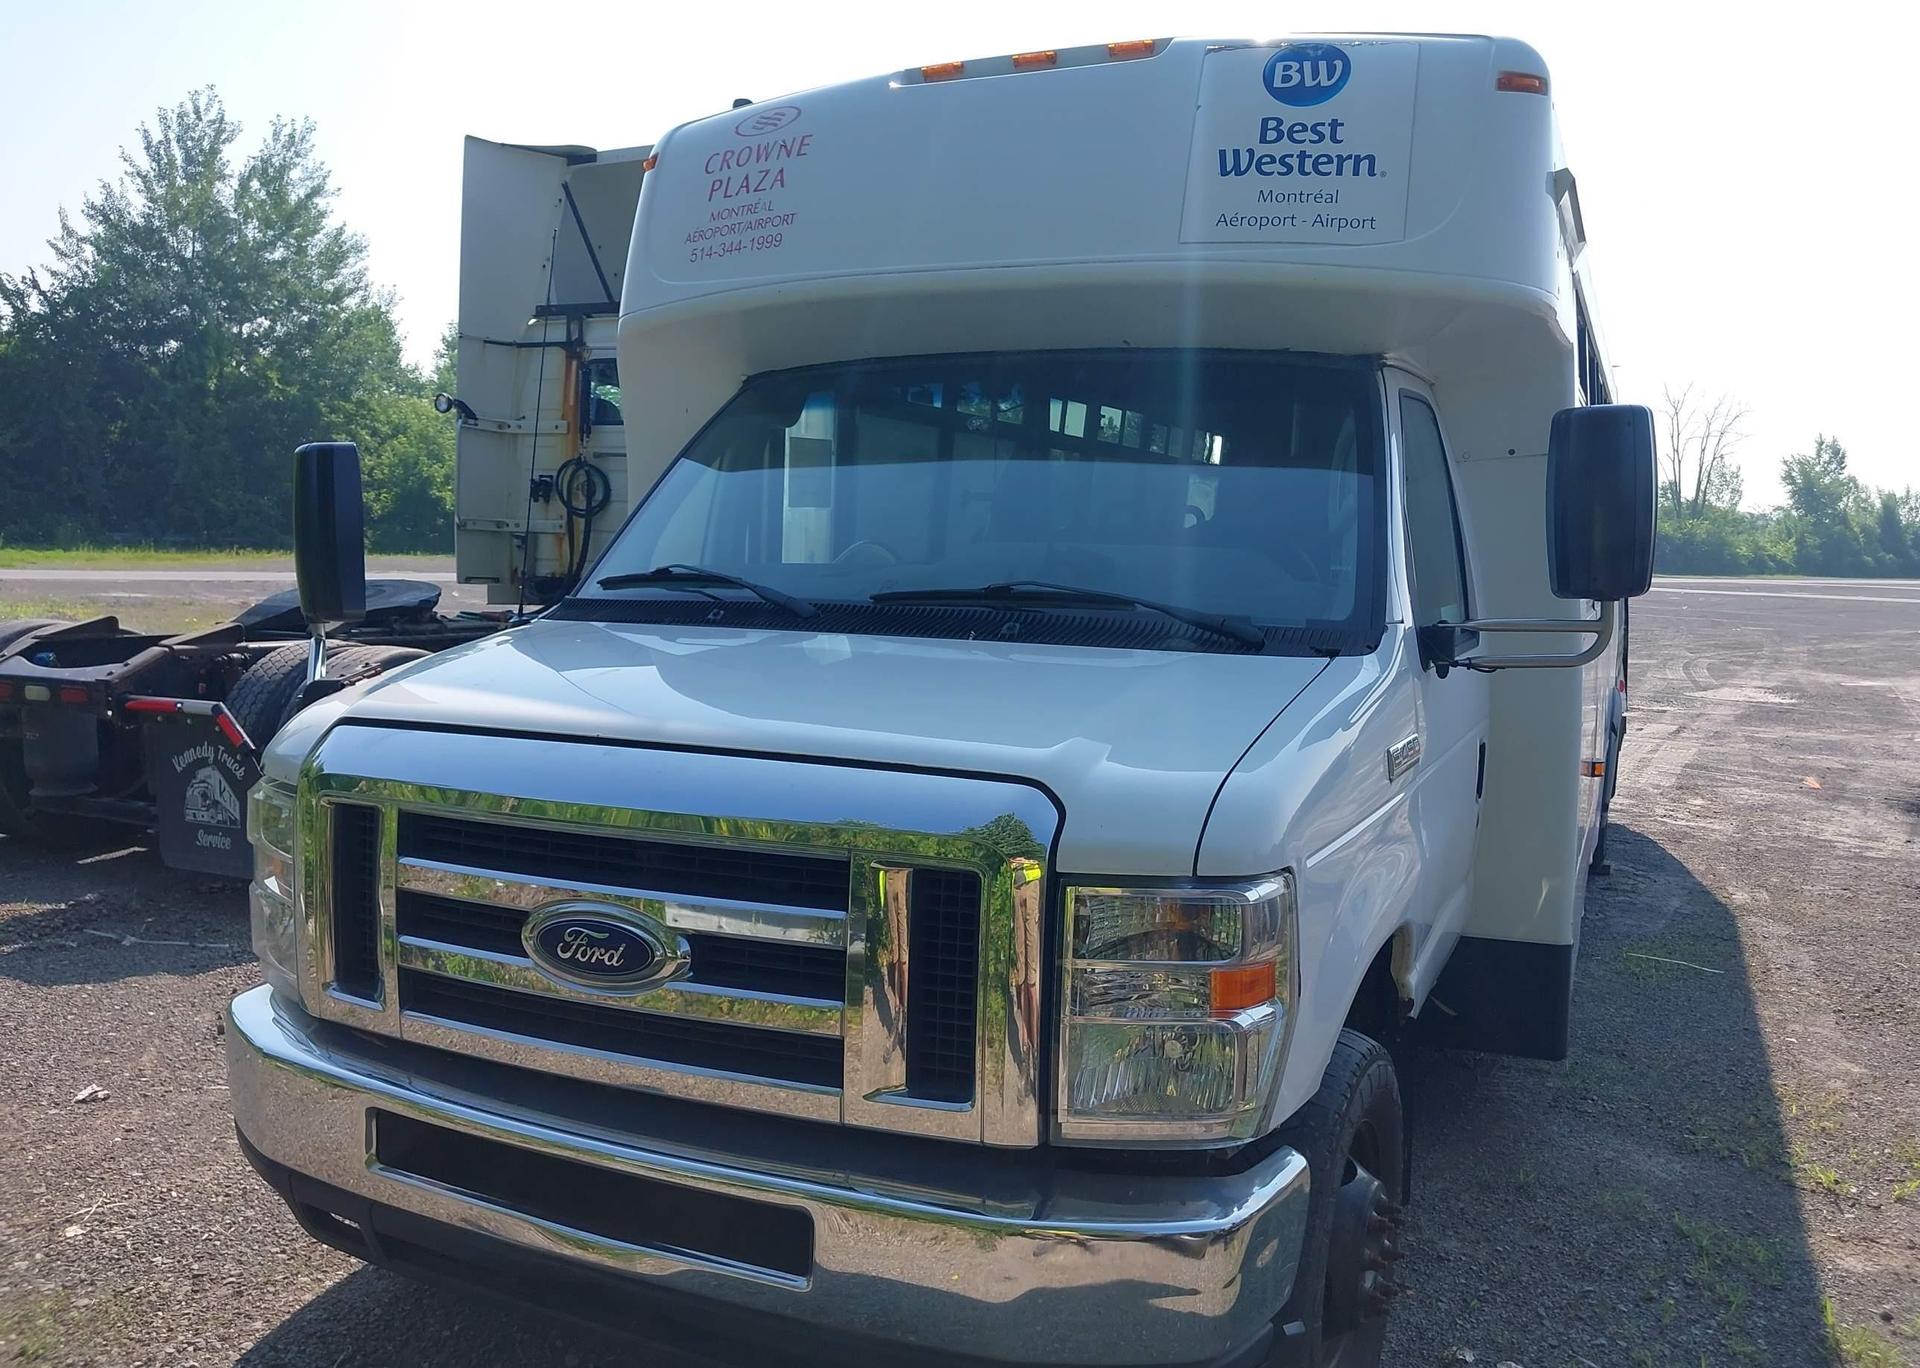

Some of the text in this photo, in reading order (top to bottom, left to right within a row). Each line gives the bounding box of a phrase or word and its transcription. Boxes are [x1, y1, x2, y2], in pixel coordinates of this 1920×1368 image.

[1272, 59, 1344, 88] BW
[1258, 116, 1345, 144] Best
[704, 134, 813, 175] CROWNE
[1217, 147, 1378, 177] Western
[708, 167, 785, 202] PLAZA
[1257, 189, 1340, 204] Montréal
[709, 197, 775, 223] MONTRÉAL
[1215, 212, 1297, 230] Aéroport
[1311, 213, 1377, 233] Airport
[689, 232, 783, 263] 514-344-1999
[171, 740, 245, 781] Kennedy Truck
[195, 828, 232, 851] Service
[556, 926, 627, 968] Ford
